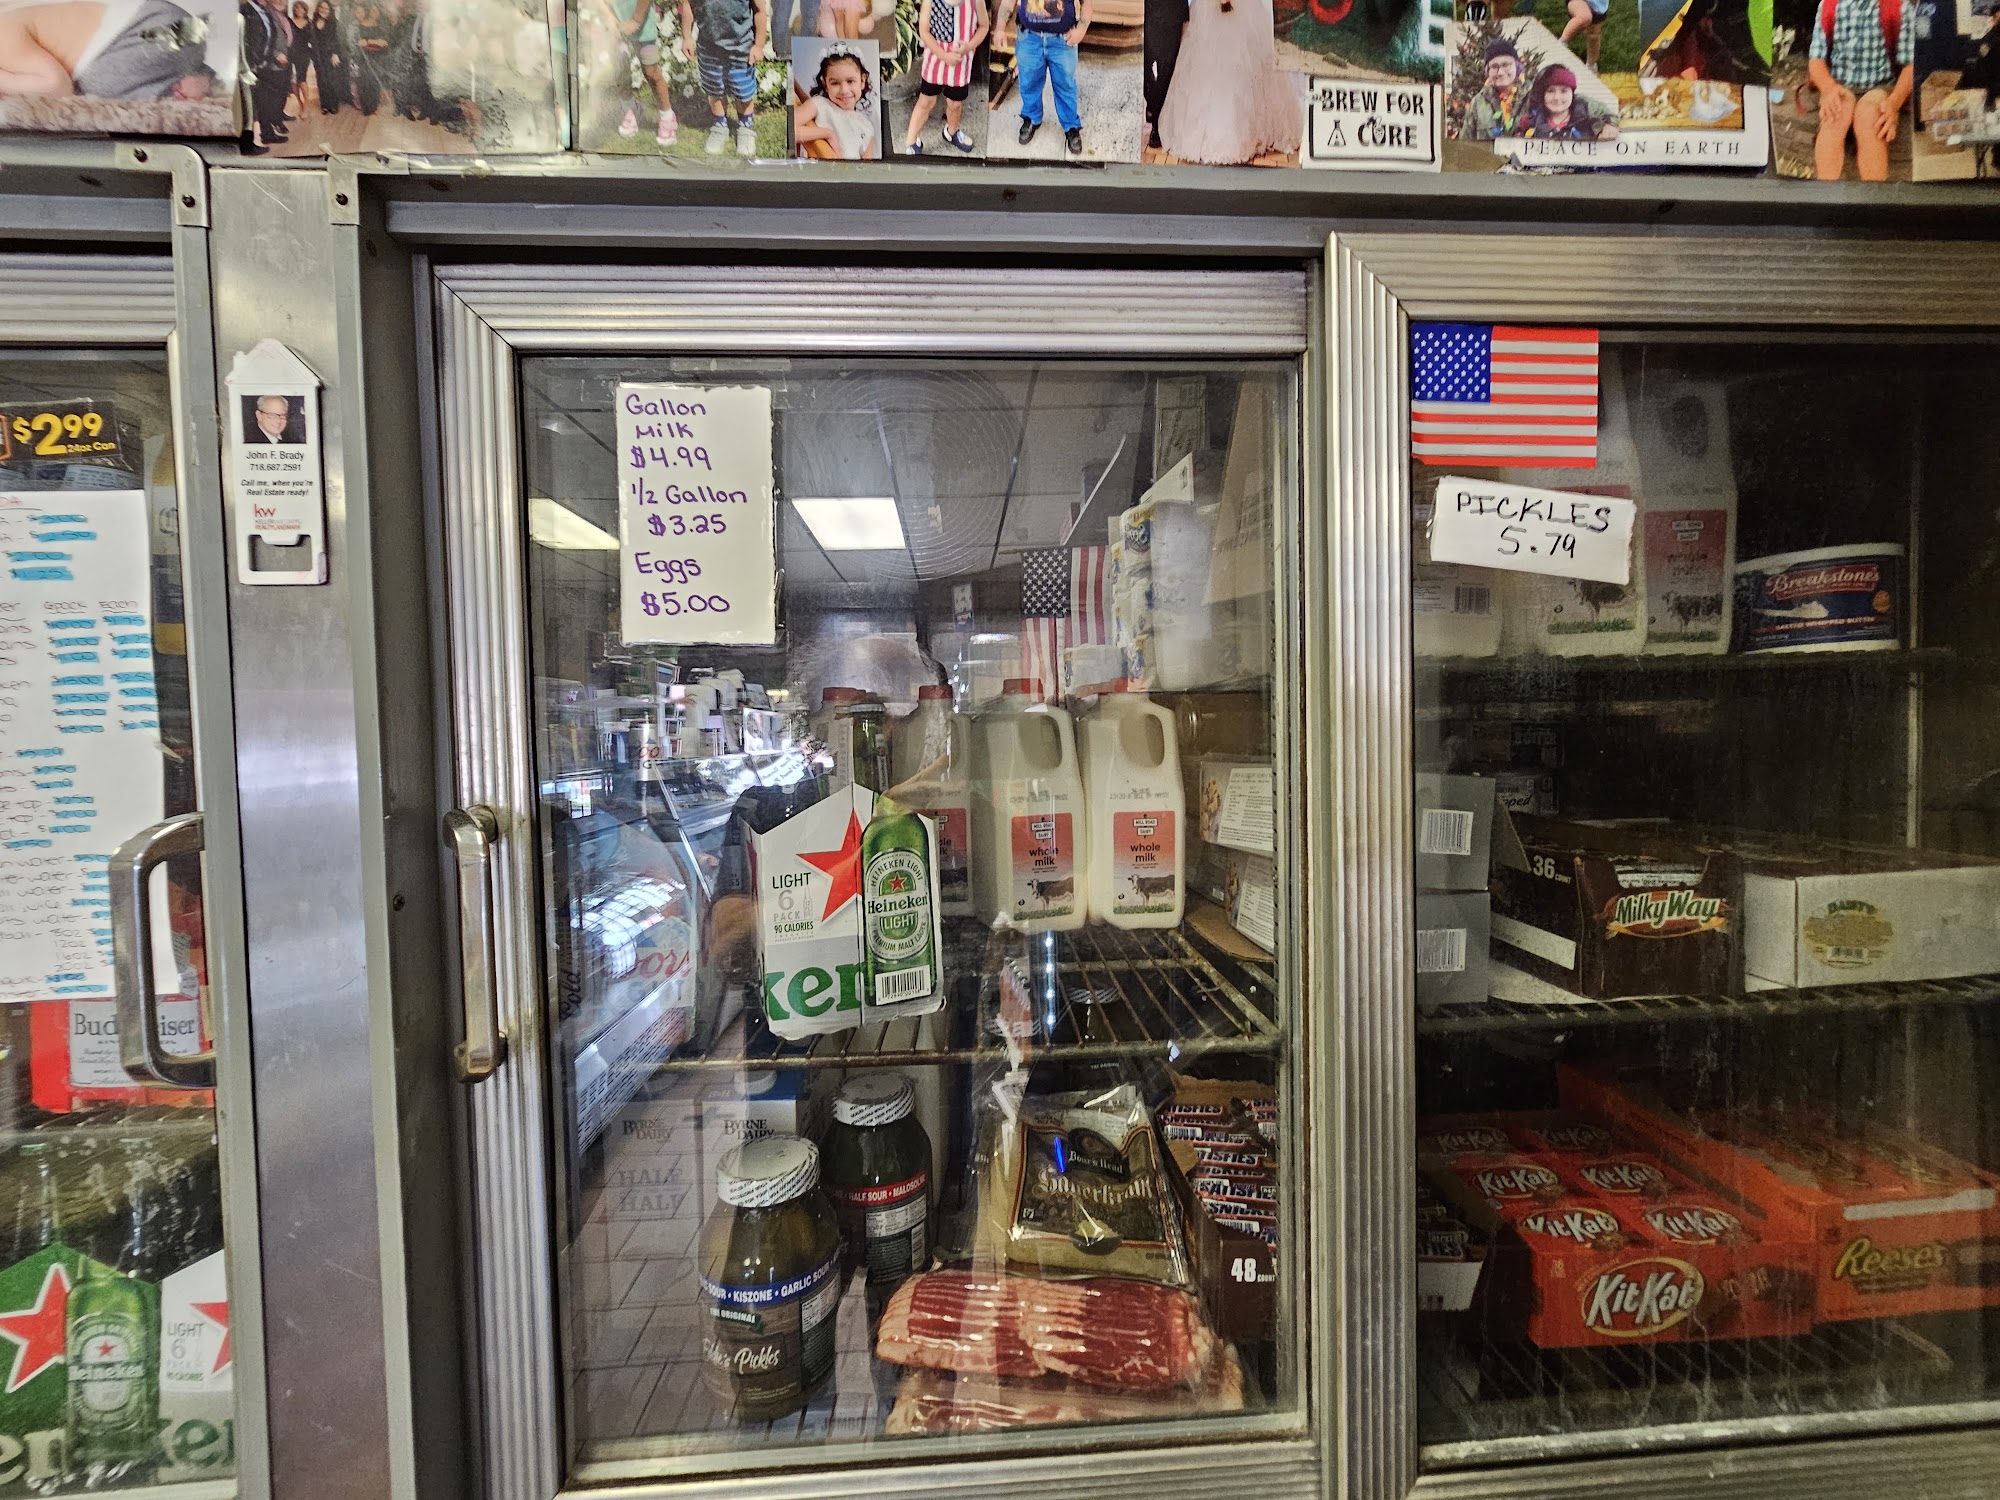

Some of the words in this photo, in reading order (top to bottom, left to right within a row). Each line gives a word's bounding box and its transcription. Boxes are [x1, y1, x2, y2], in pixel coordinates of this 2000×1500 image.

[1322, 88, 1378, 113] BREW
[1386, 92, 1425, 116] FOR
[1357, 122, 1418, 149] CURE
[1523, 141, 1598, 157] PEACE
[1616, 141, 1647, 156] ON
[1665, 141, 1741, 156] EARTH
[626, 393, 707, 417] Gallon
[636, 422, 694, 440] Milk
[67, 443, 92, 453] 24oz
[93, 441, 117, 451] Can
[246, 451, 268, 460] John
[270, 451, 277, 460] F.
[279, 451, 305, 462] Brady
[630, 445, 713, 471] $4.99
[250, 463, 302, 472] 718.687.2591
[241, 479, 255, 487] Call
[632, 477, 658, 505] 1/2
[665, 484, 748, 505] Gallon
[286, 489, 310, 498] ready!
[254, 503, 277, 518] kw
[1457, 491, 1611, 533] PICKLES
[648, 513, 727, 537] $3.25
[1498, 525, 1576, 559] 5.79
[634, 552, 702, 584] Eggs
[641, 591, 730, 617] $5.00
[1029, 846, 1059, 857] whole
[1130, 842, 1161, 852] whole
[1034, 856, 1055, 867] milk
[1135, 853, 1156, 863] milk
[1533, 854, 1556, 880] 36
[772, 872, 812, 889] LIGHT
[871, 860, 905, 887] HEINEKEN
[907, 860, 924, 881] LIGHT
[778, 889, 795, 911] 6
[867, 894, 928, 915] Heineken
[773, 911, 801, 922] PACK
[884, 913, 916, 929] LIGHT
[773, 924, 783, 934] 90
[784, 921, 814, 932] CALORIES
[872, 928, 897, 952] PREMIUM
[897, 939, 915, 951] MALT
[913, 921, 927, 942] LAGER
[74, 1013, 195, 1036] Budiser
[622, 1119, 665, 1136] BYRNE
[636, 1128, 673, 1140] DAIRY
[724, 1119, 768, 1136] BYRNE
[849, 1191, 867, 1202] HALF
[867, 1190, 888, 1202] SOUR
[1230, 1257, 1257, 1283] 48
[733, 1289, 773, 1303] KISZONE
[780, 1276, 812, 1298] GARLIC
[812, 1262, 830, 1282] SOUR
[166, 1322, 205, 1337] LIGHT
[171, 1338, 186, 1360] 6
[733, 1345, 780, 1375] Pickles
